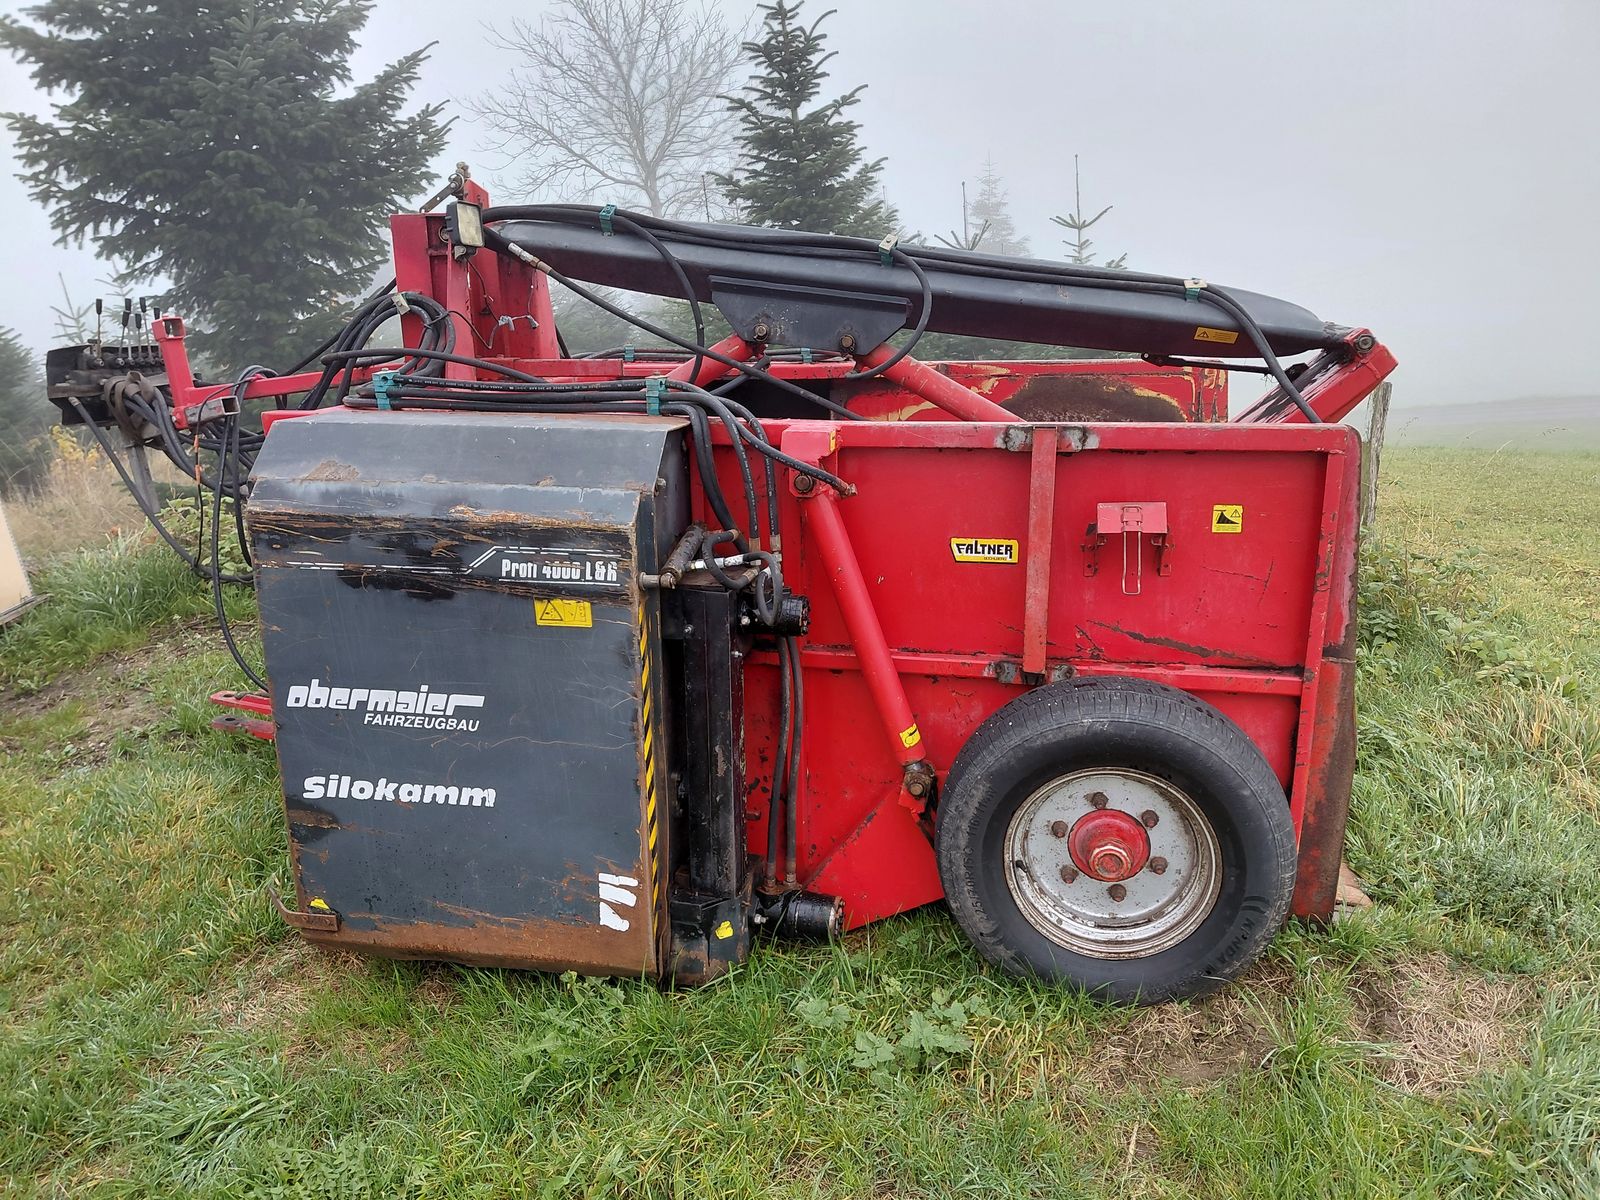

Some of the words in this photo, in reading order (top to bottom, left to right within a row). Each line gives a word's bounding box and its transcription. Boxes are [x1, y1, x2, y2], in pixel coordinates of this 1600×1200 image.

[955, 540, 1013, 560] FALTNER
[542, 560, 581, 579] 4000
[286, 679, 486, 715] obermaier
[363, 713, 480, 732] FAHRZEUGBAU
